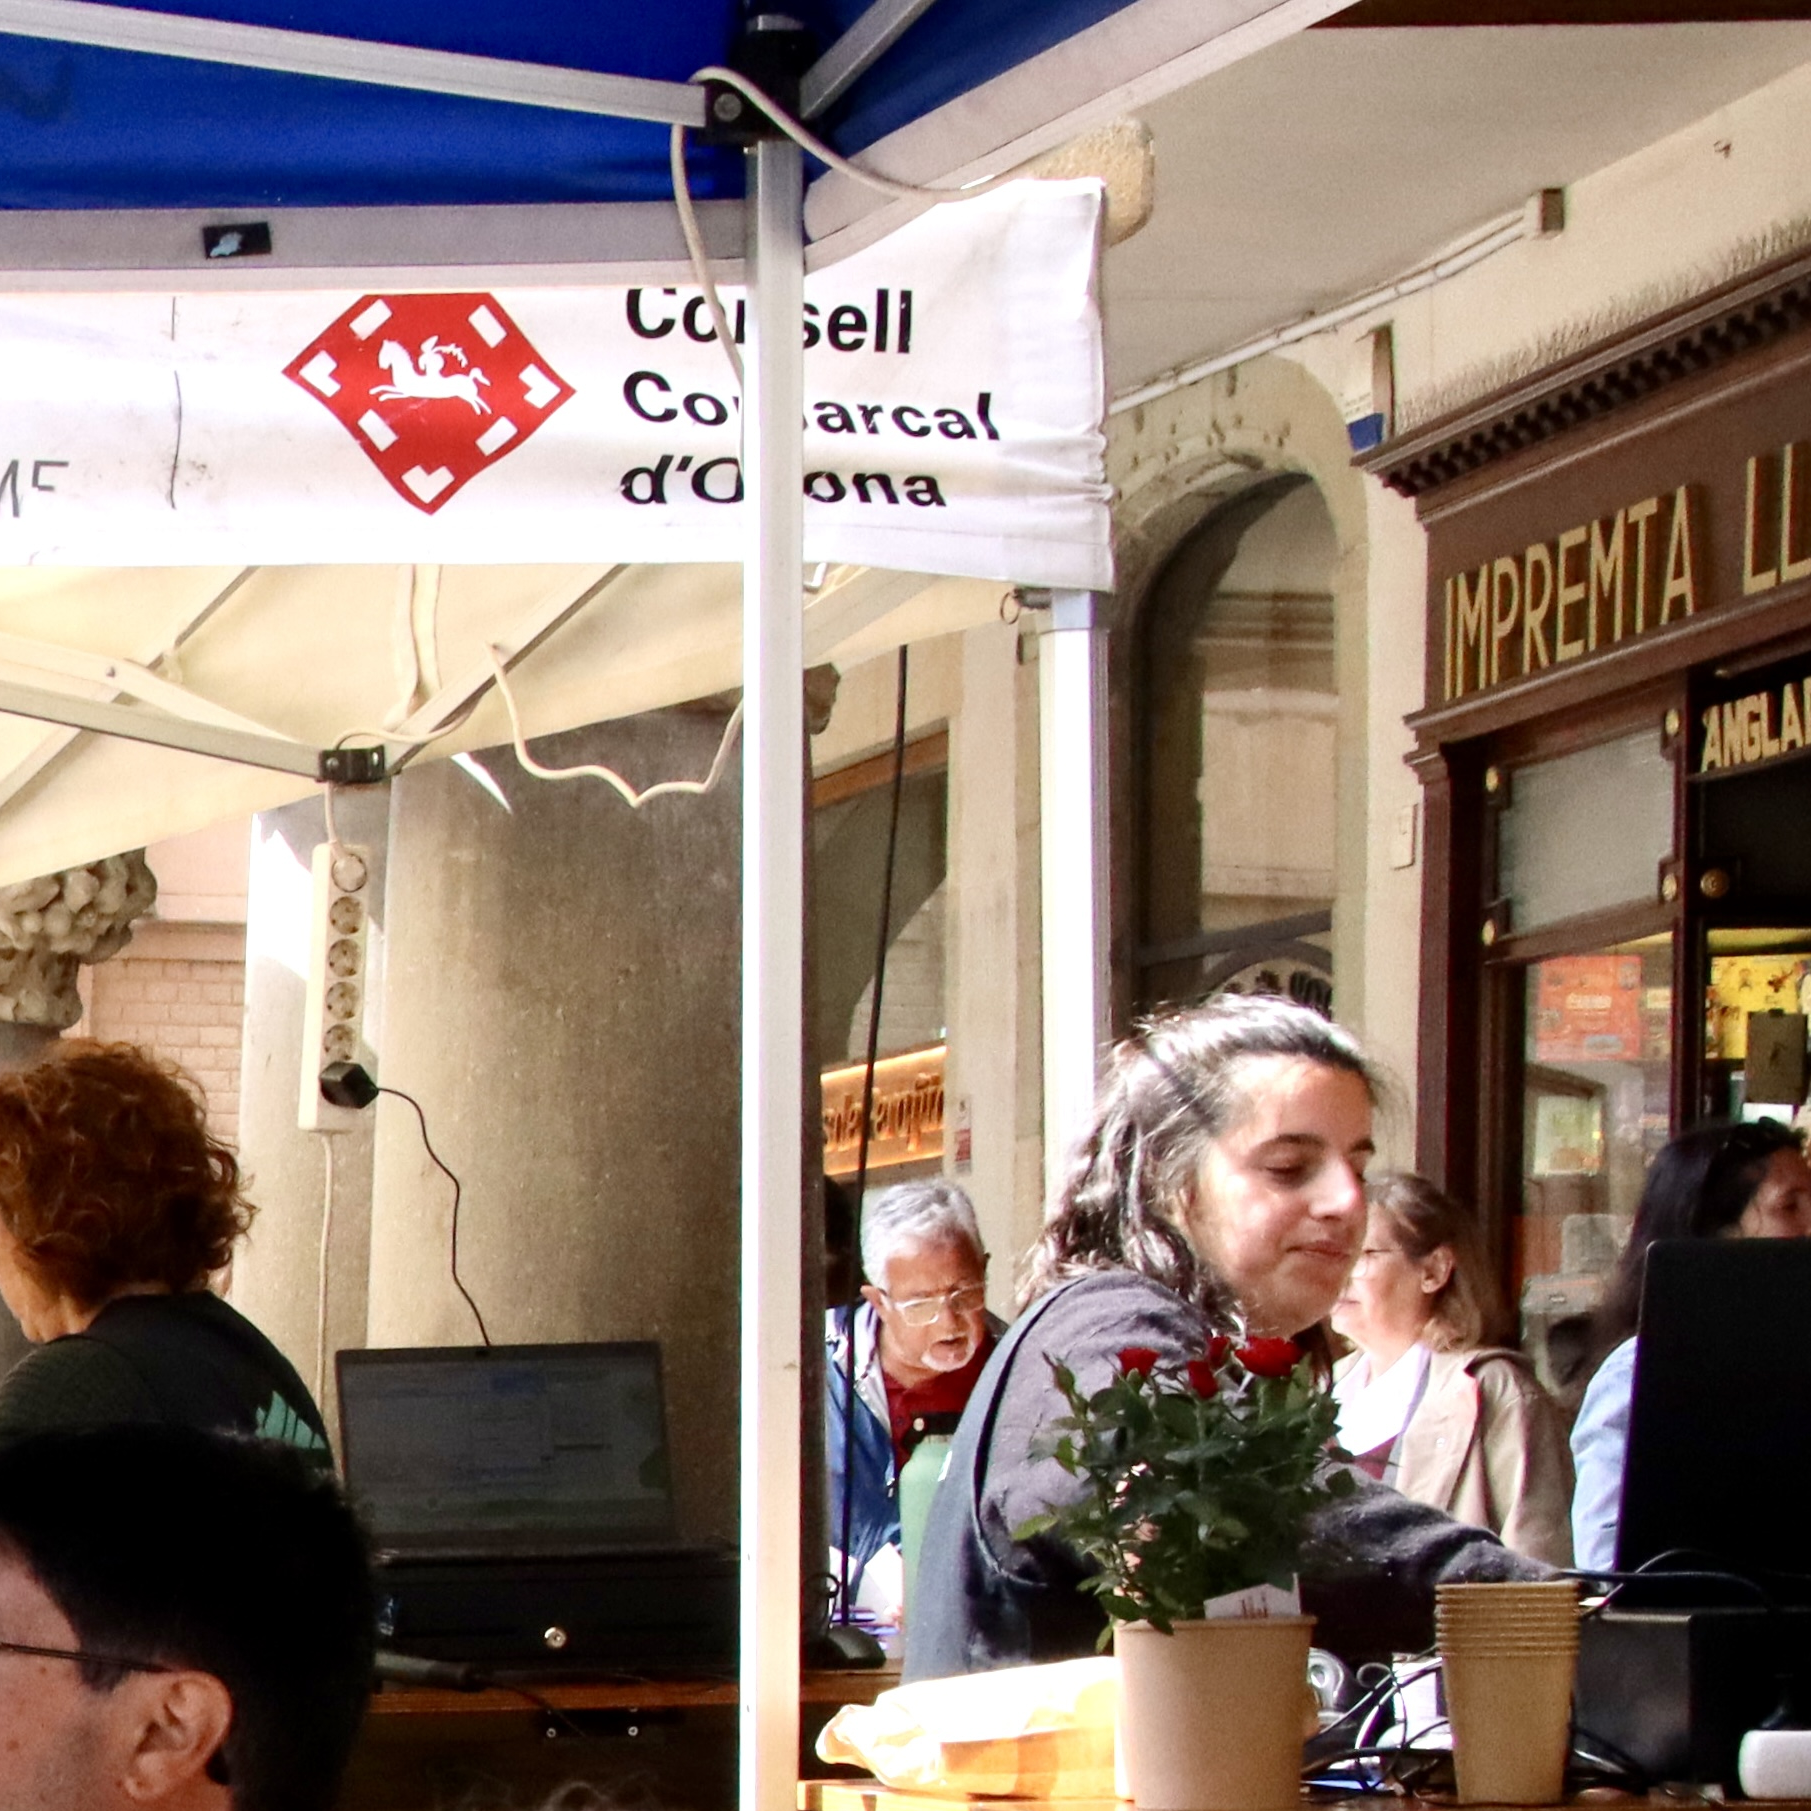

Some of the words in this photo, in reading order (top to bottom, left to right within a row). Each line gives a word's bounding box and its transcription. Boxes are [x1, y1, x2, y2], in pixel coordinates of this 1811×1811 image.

[622, 369, 1001, 441] Coarcal
[1443, 484, 1699, 701] IMPREMTA
[1700, 676, 1811, 773] ANGLA
